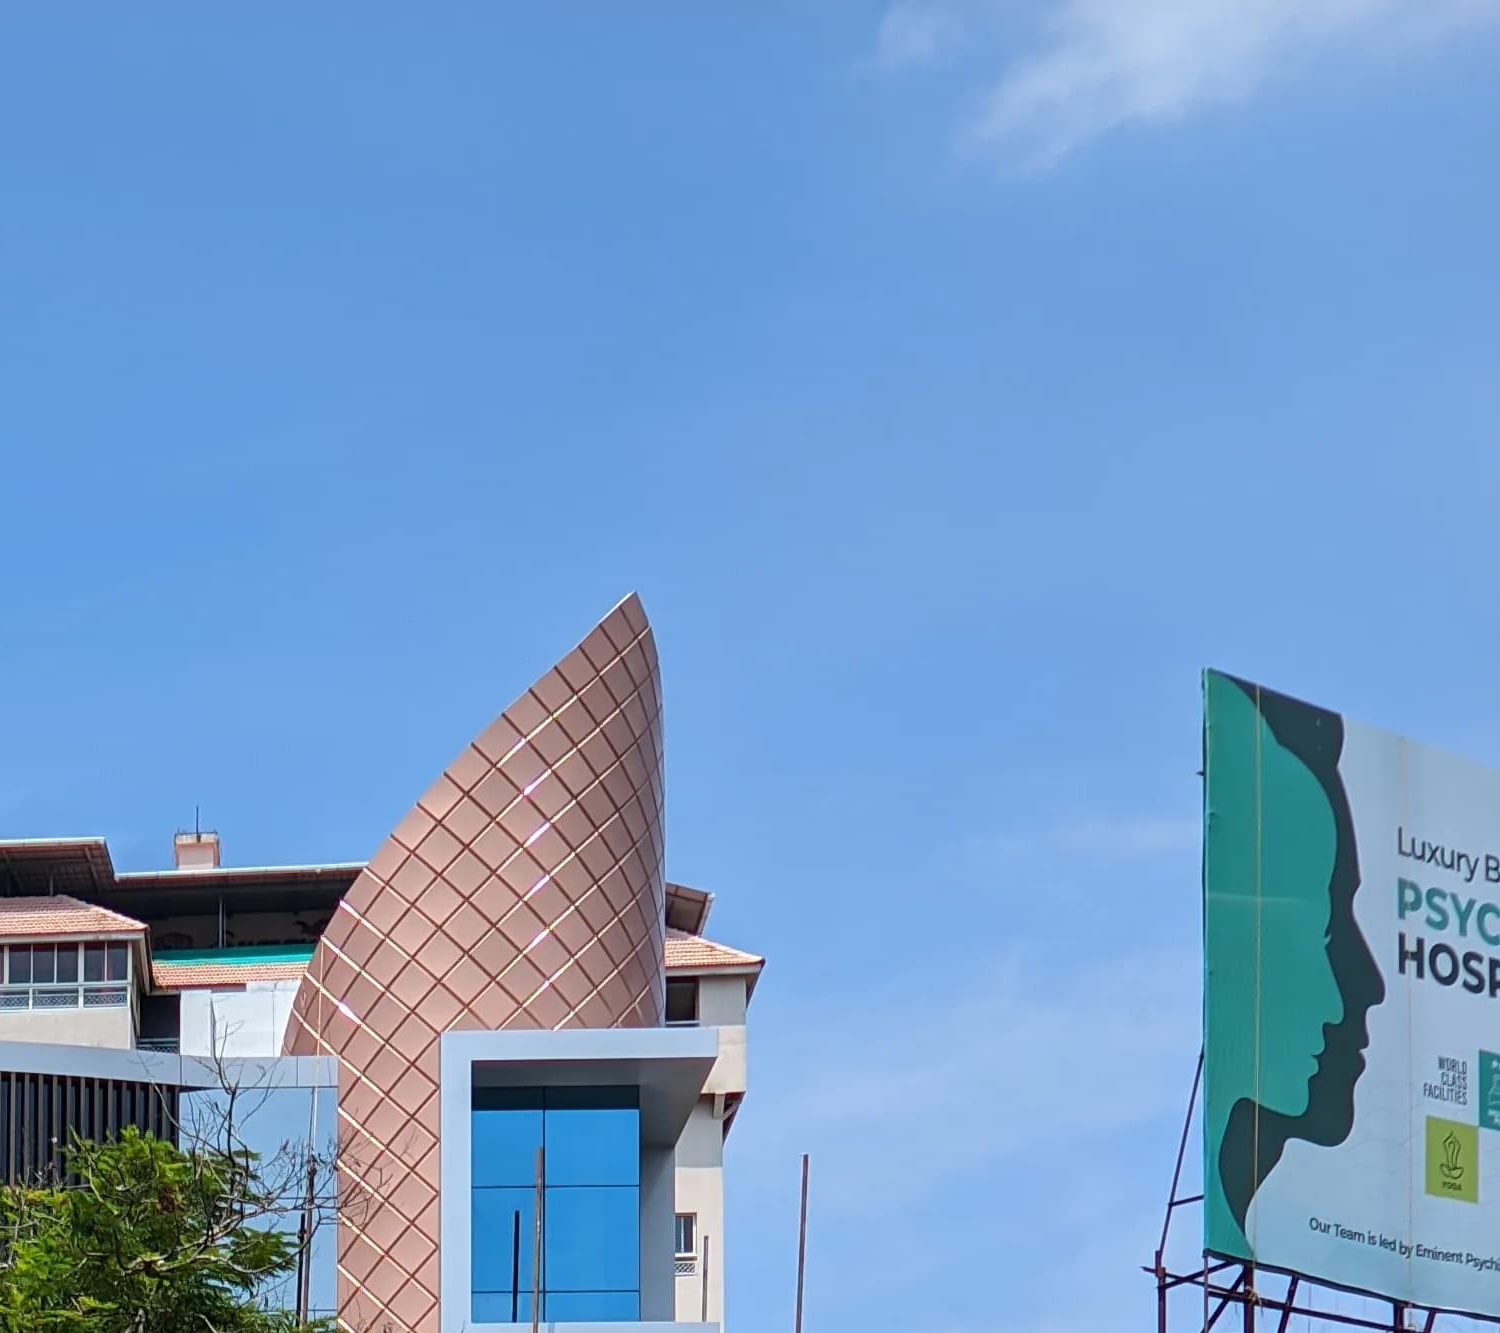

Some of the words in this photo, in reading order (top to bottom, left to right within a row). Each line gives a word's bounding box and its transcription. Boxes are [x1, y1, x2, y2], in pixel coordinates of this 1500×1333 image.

[1397, 826, 1479, 882] Luxury
[1437, 1056, 1467, 1075] WORLD
[1441, 1072, 1467, 1090] CLASS
[1423, 1083, 1468, 1105] FACILITIES
[1309, 1217, 1331, 1234] Our
[1334, 1223, 1365, 1243] Team
[1368, 1230, 1377, 1246] is
[1379, 1233, 1396, 1252] led
[1400, 1241, 1413, 1259] by
[1416, 1244, 1463, 1264] Eminent
